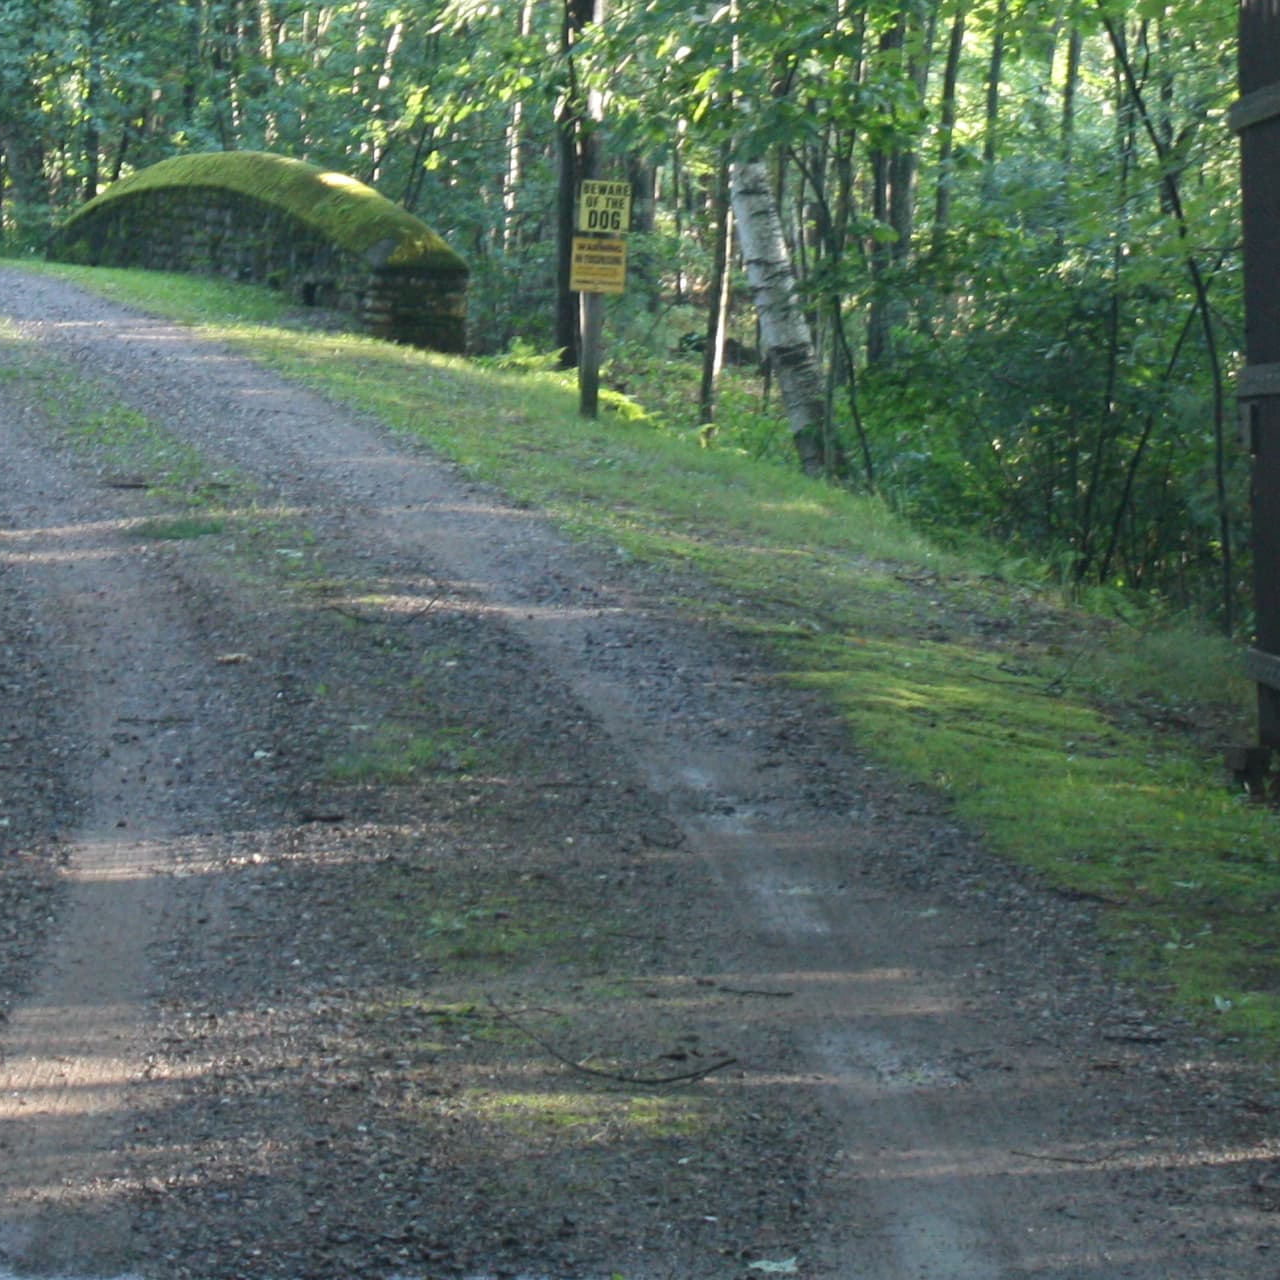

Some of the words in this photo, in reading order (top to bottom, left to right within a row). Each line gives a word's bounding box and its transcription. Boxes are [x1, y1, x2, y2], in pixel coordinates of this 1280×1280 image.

[583, 183, 631, 196] BEWARE
[586, 197, 599, 208] OF
[605, 198, 625, 209] THE
[588, 210, 620, 230] DOG
